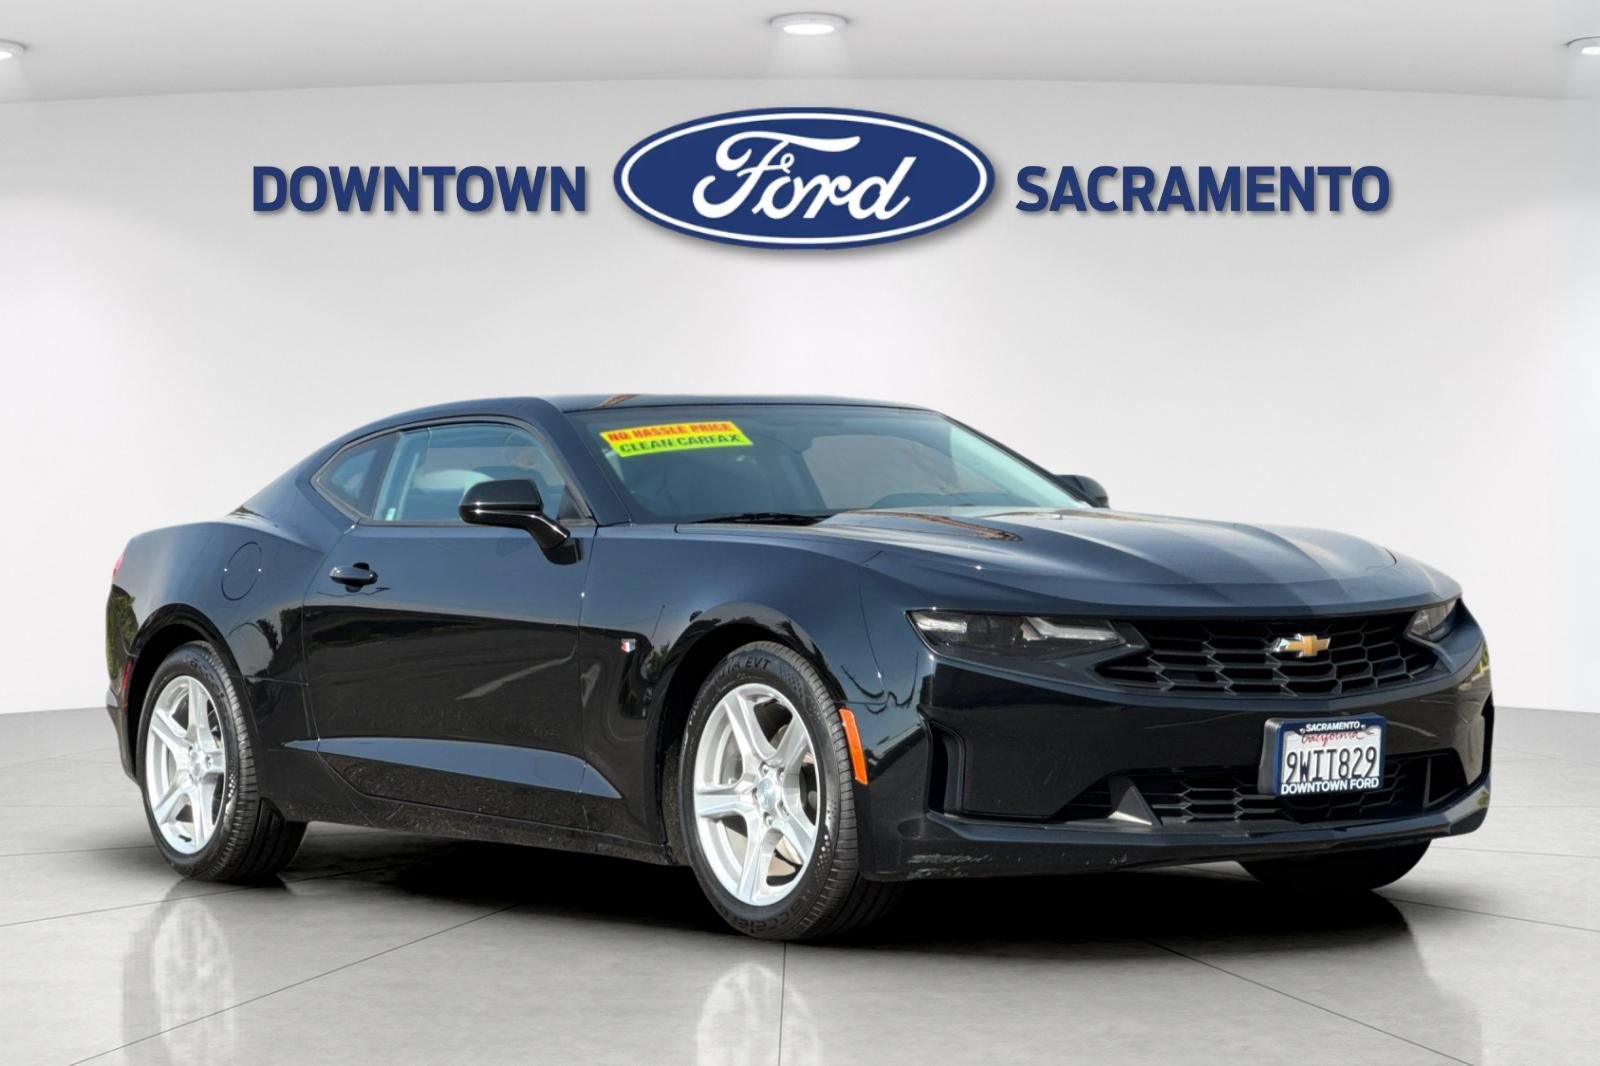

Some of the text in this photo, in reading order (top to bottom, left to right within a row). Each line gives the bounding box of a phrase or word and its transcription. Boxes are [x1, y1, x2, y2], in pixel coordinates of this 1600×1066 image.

[252, 130, 1391, 220] DOWNTOWN Ford SACRAMENTO
[608, 422, 732, 442] NO HASSLE PRICE
[619, 434, 741, 453] CLEAN CARFAX
[745, 656, 772, 670] EVT
[1305, 720, 1361, 732] SACRAMENTO
[1286, 746, 1377, 783] 9WIT829
[1280, 777, 1380, 795] DOWNTOWN FORD
